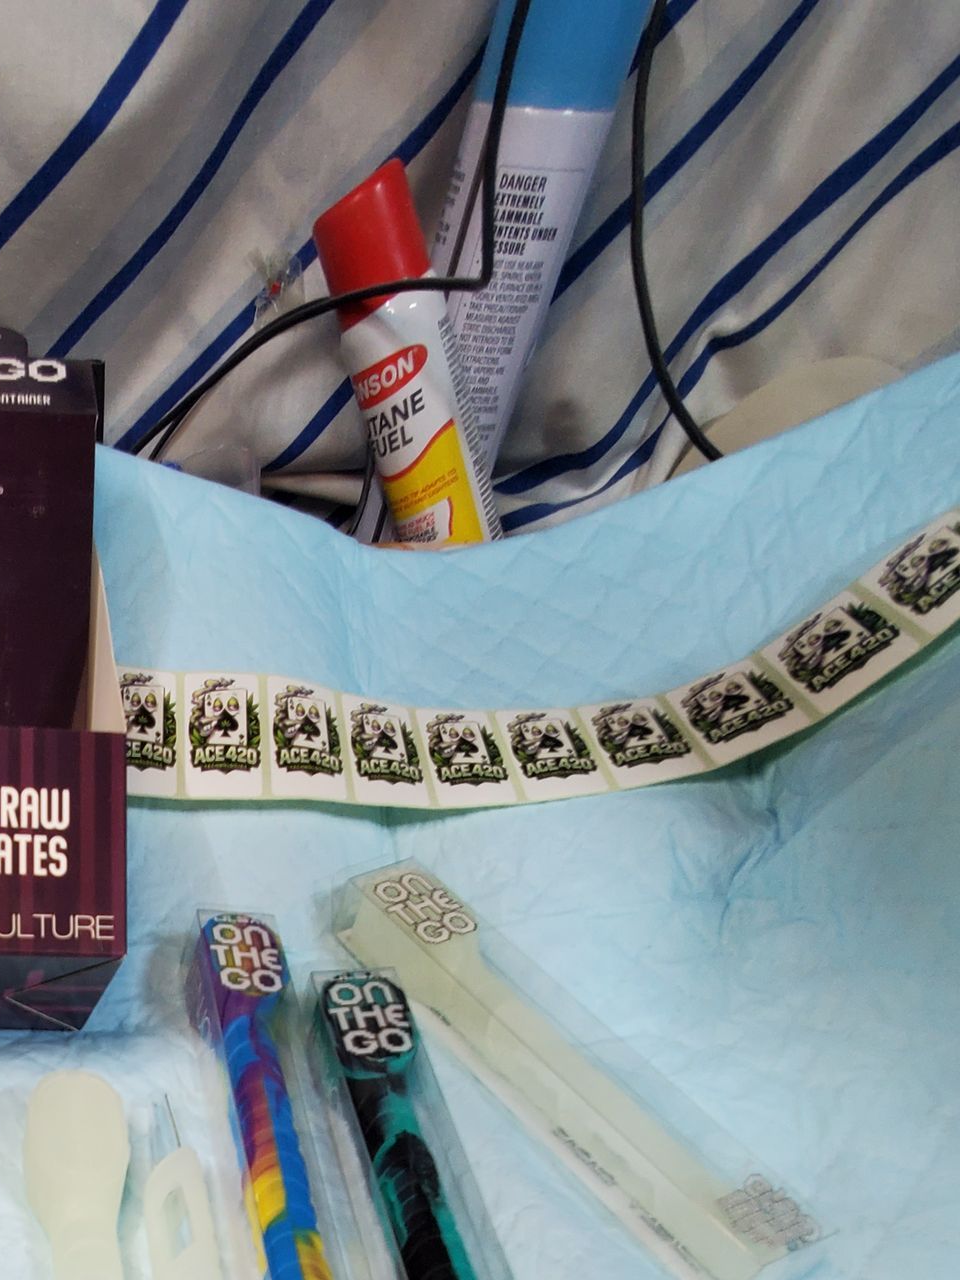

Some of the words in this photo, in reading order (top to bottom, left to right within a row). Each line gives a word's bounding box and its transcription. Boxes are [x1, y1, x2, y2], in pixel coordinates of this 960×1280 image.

[499, 173, 547, 192] DANGER
[494, 208, 544, 225] LAMMABLE
[531, 227, 558, 241] UNDER
[356, 350, 416, 401] NSON
[142, 744, 173, 765] 420
[194, 747, 225, 764] ACE
[225, 747, 258, 765] 420
[280, 748, 312, 765] ACE
[311, 753, 341, 771] 420
[360, 759, 389, 777] ACE
[390, 761, 420, 780] 420
[441, 764, 470, 781] ACE
[470, 764, 505, 780] 420
[526, 759, 559, 776] ACE
[386, 889, 463, 926] THE
[212, 924, 271, 947] ON
[415, 911, 477, 944] GO
[209, 944, 282, 971] THE
[220, 967, 282, 992] GO
[328, 981, 394, 1005] ON
[328, 1003, 410, 1030] THE
[342, 1028, 413, 1055] GO
